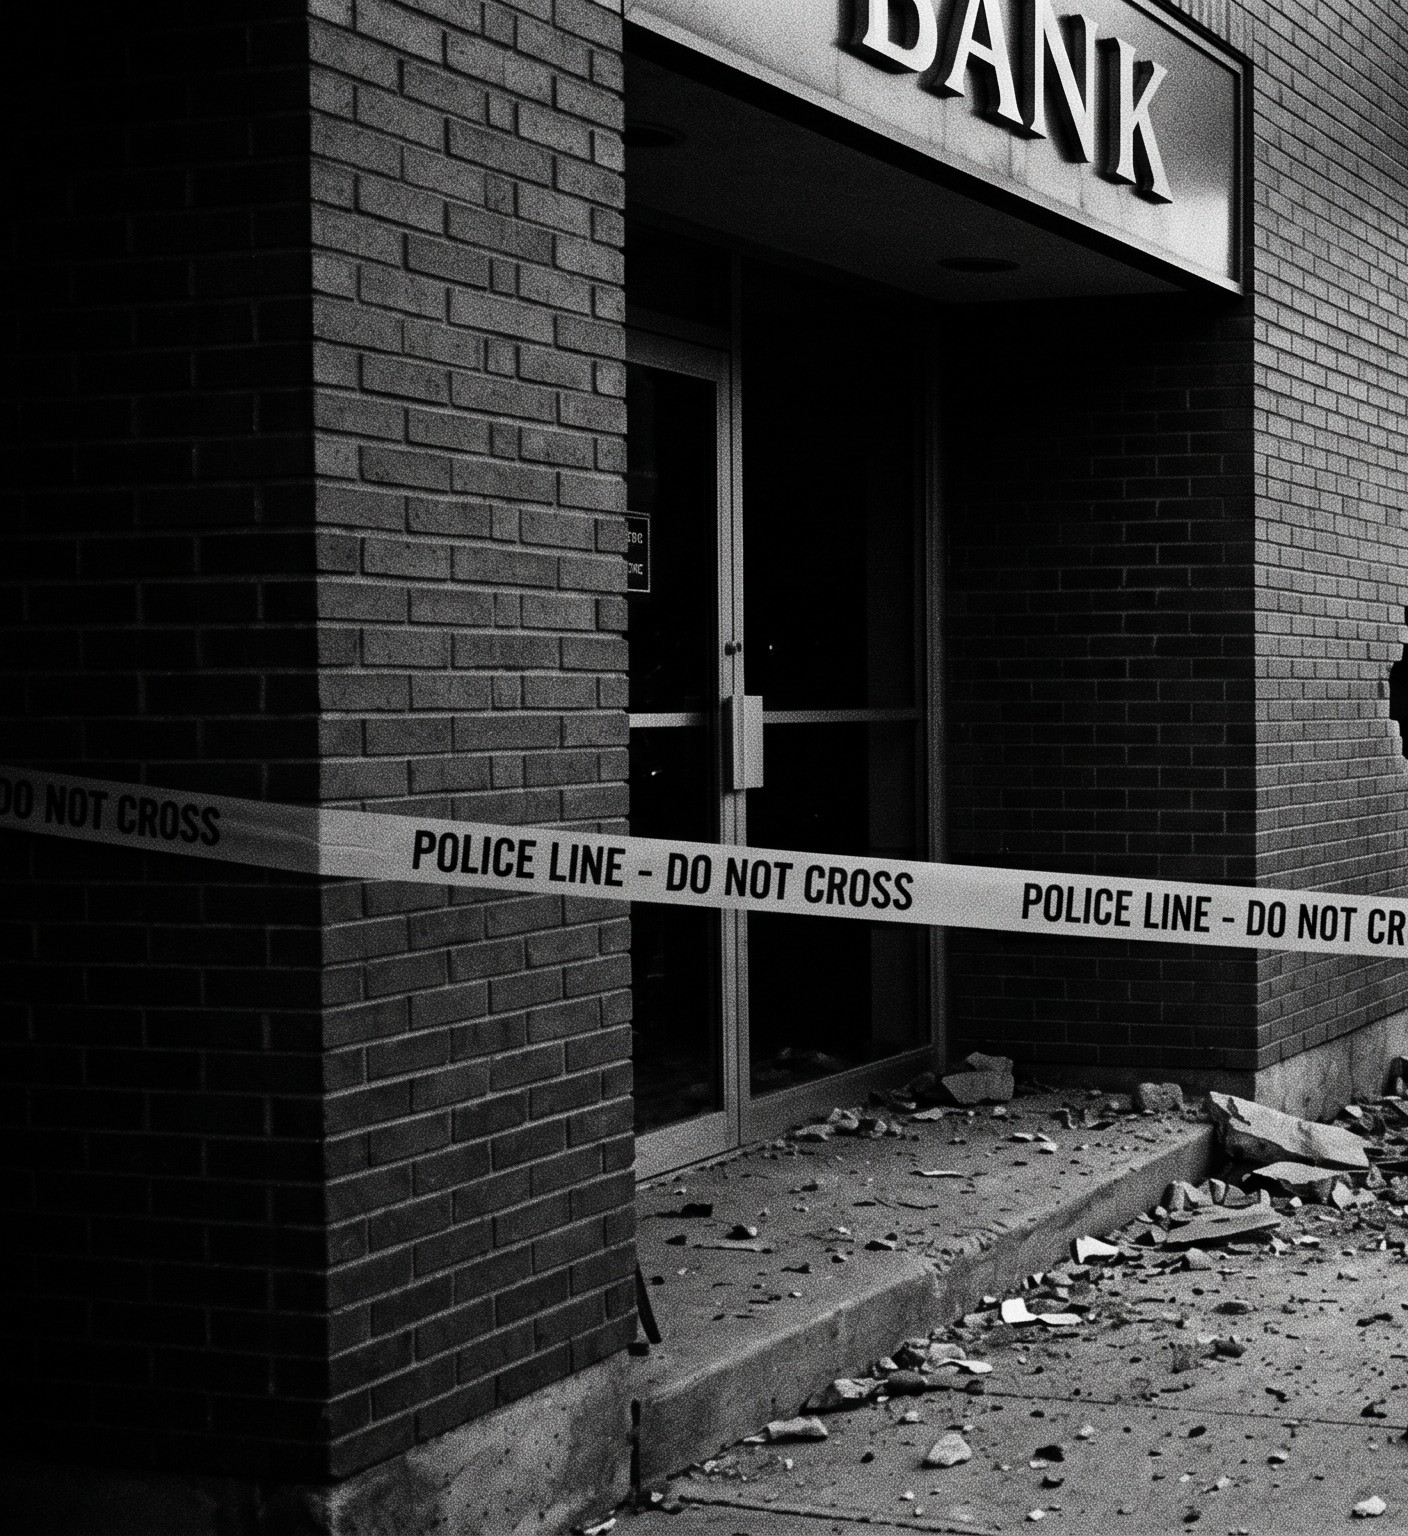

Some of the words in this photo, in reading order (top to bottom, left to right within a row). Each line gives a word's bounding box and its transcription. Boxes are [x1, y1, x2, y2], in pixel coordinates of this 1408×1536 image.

[45, 783, 109, 830] NOT
[117, 794, 221, 846] CROSS
[411, 829, 538, 880] POLICE
[549, 841, 626, 888] LINE
[665, 852, 713, 895] DO
[724, 857, 794, 900] NOT
[803, 864, 915, 911] CROSS
[1021, 882, 1133, 927] POLICE
[1143, 892, 1213, 933] LINE
[1246, 899, 1287, 939] DO
[1298, 903, 1359, 943] NOT
